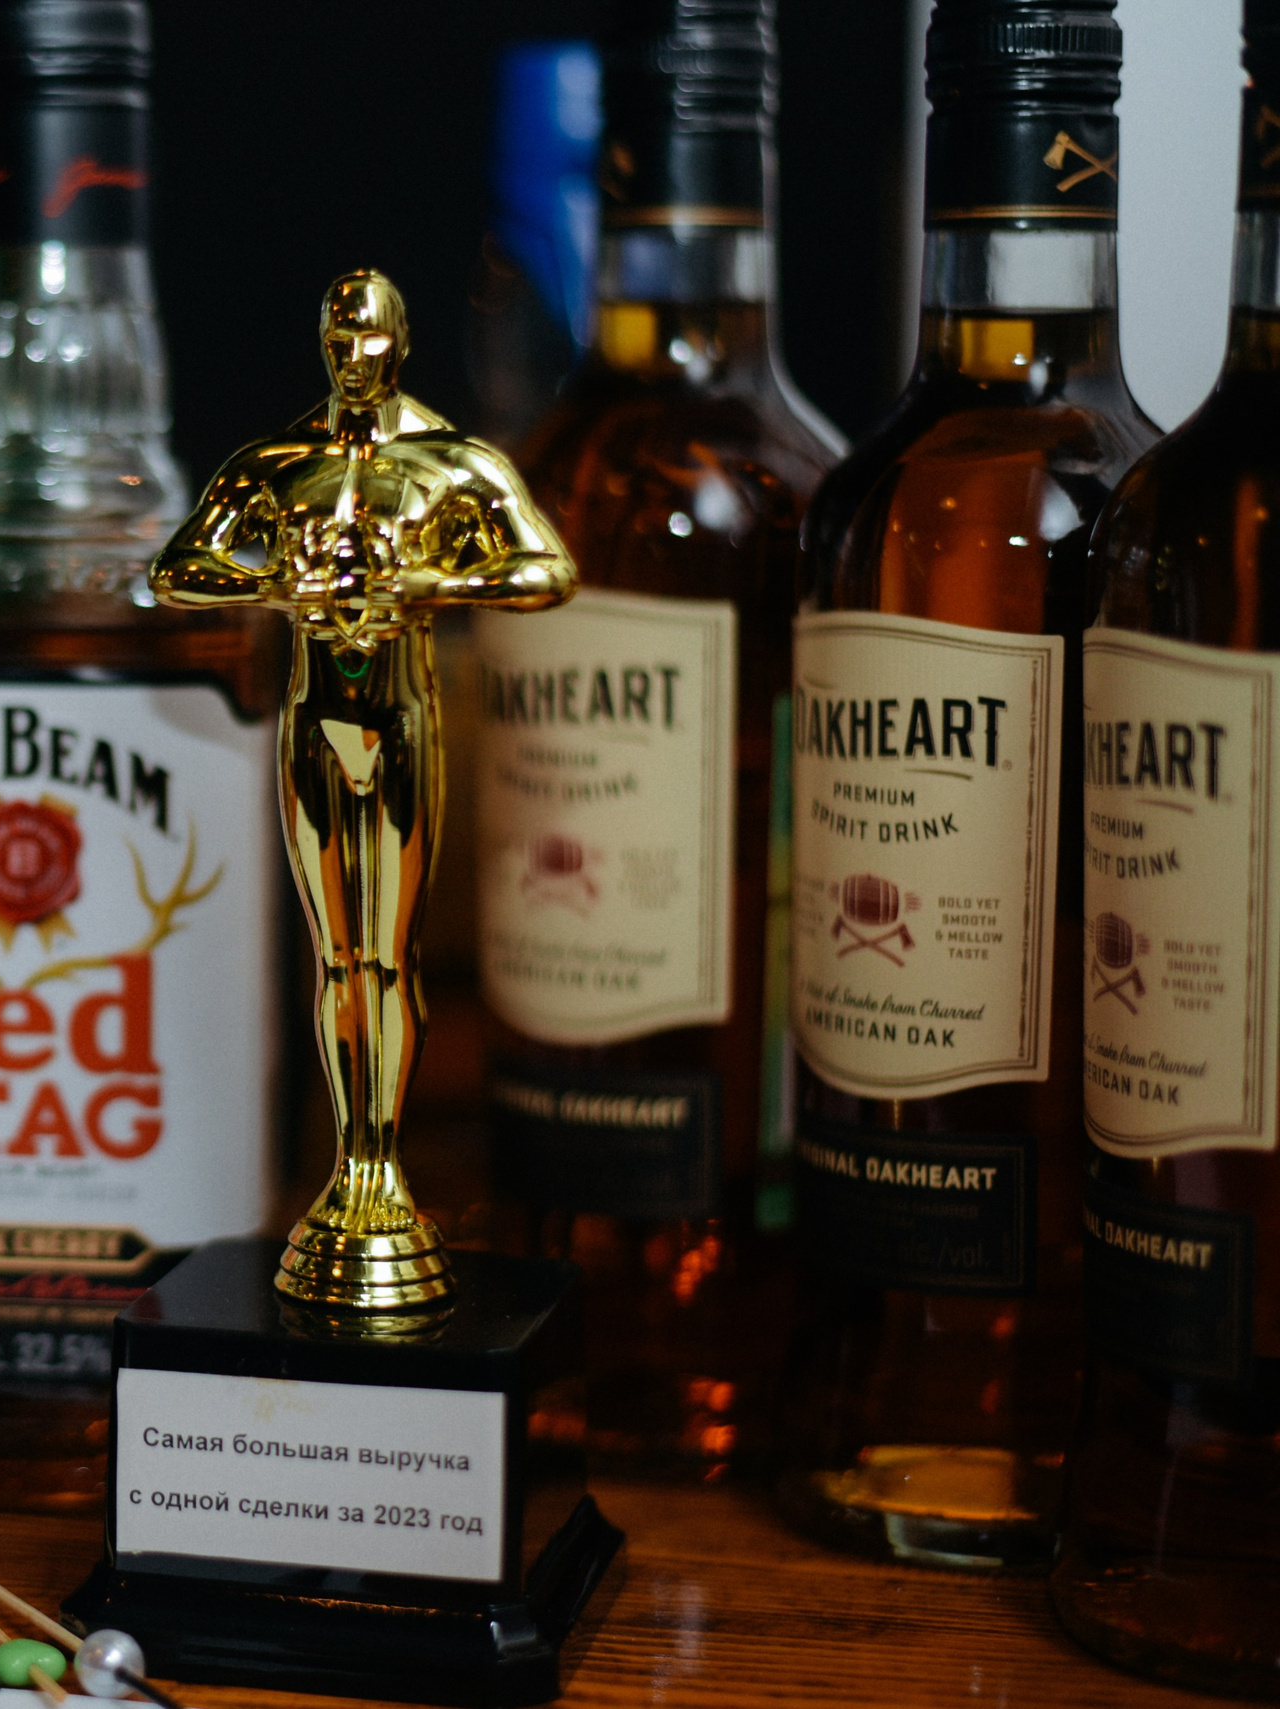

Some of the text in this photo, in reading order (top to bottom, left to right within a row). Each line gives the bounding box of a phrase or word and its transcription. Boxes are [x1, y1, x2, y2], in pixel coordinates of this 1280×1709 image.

[796, 686, 1007, 769] OAKHEART
[2, 706, 171, 834] BEAM
[1085, 721, 1227, 802] KHEART
[833, 781, 915, 807] PREMIUM
[811, 799, 959, 843] SPIRIT DRINK
[1090, 811, 1144, 840] PREMIUM
[1116, 848, 1180, 880] DRINK
[937, 896, 1001, 910] BOLD YET
[941, 914, 997, 927] SMOOTH
[947, 931, 1003, 944] MELLOW
[948, 948, 989, 961] TASTE
[839, 988, 879, 1012] Smoke
[880, 993, 917, 1016] from
[920, 998, 986, 1021] Charred
[806, 1006, 956, 1048] AMERICAN OAK
[1119, 1044, 1145, 1067] from
[1149, 1049, 1208, 1078] Charred
[1084, 1060, 1180, 1107] ERICAN OAK
[865, 1156, 997, 1190] OAKHEART
[1105, 1221, 1214, 1271] OAKHEART
[143, 1427, 470, 1473] Самая большая выручка
[129, 1489, 483, 1536] с одной сделки за 2023 год
